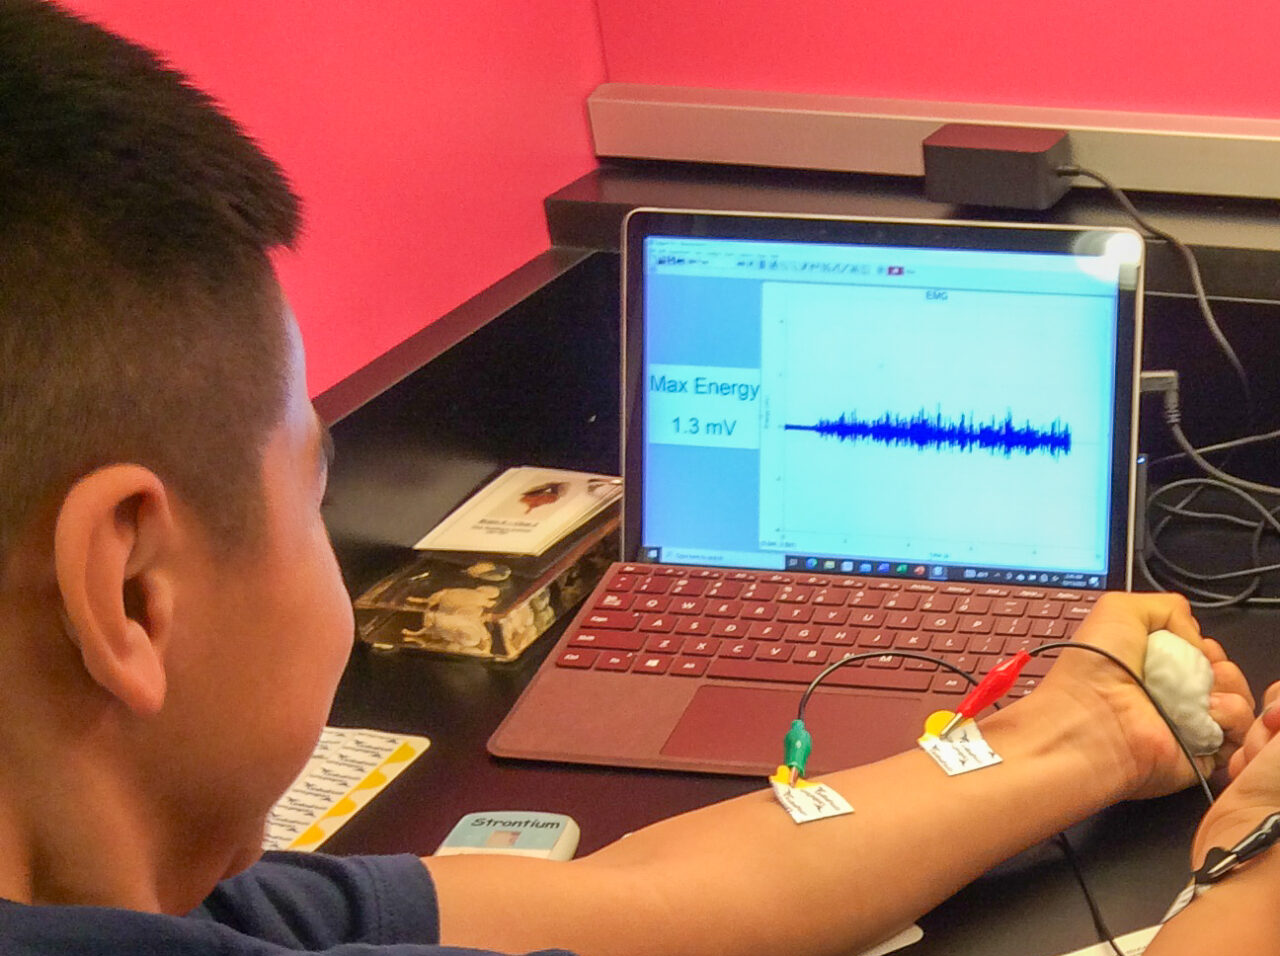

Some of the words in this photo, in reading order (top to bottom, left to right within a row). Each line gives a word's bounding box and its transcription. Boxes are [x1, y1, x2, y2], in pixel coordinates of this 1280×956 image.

[649, 375, 689, 393] Max
[695, 376, 760, 402] Energy
[672, 416, 700, 435] 1.3
[705, 419, 737, 436] mV
[470, 818, 561, 829] Strontium
